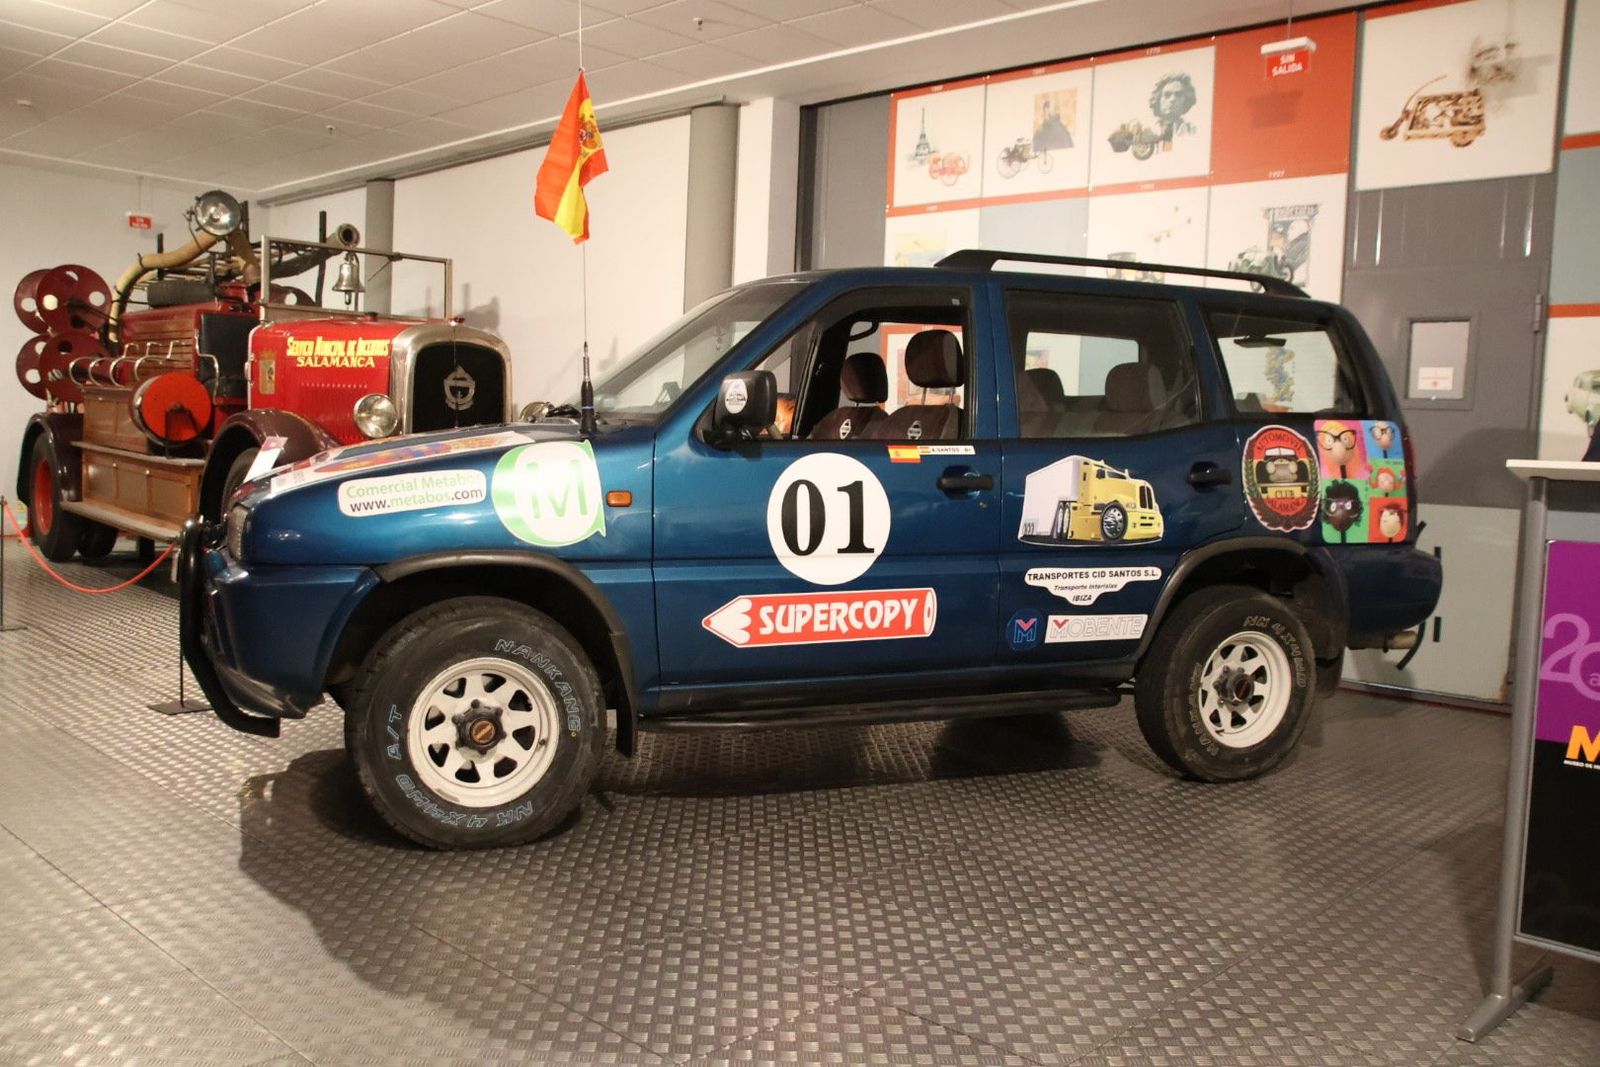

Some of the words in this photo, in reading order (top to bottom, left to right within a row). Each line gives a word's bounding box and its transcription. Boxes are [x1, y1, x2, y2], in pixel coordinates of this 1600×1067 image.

[1272, 62, 1303, 77] SALIDA
[1280, 53, 1296, 64] SIN
[296, 356, 375, 368] SALAMANCA
[345, 477, 419, 499] Comercial
[420, 472, 483, 492] Metabos
[350, 486, 483, 513] www.metabos.com
[781, 479, 875, 557] 01
[1027, 571, 1090, 581] TRANSPORTES
[1092, 570, 1106, 579] CID
[1109, 569, 1142, 578] SANTOS
[1143, 569, 1159, 578] S.L.
[1054, 583, 1088, 591] Transporte
[1072, 594, 1092, 602] IBIZA
[759, 598, 919, 635] SUPERCOPY
[1050, 617, 1144, 639] MOBENTE
[495, 638, 582, 732] NANKANG
[386, 704, 403, 760] A/T
